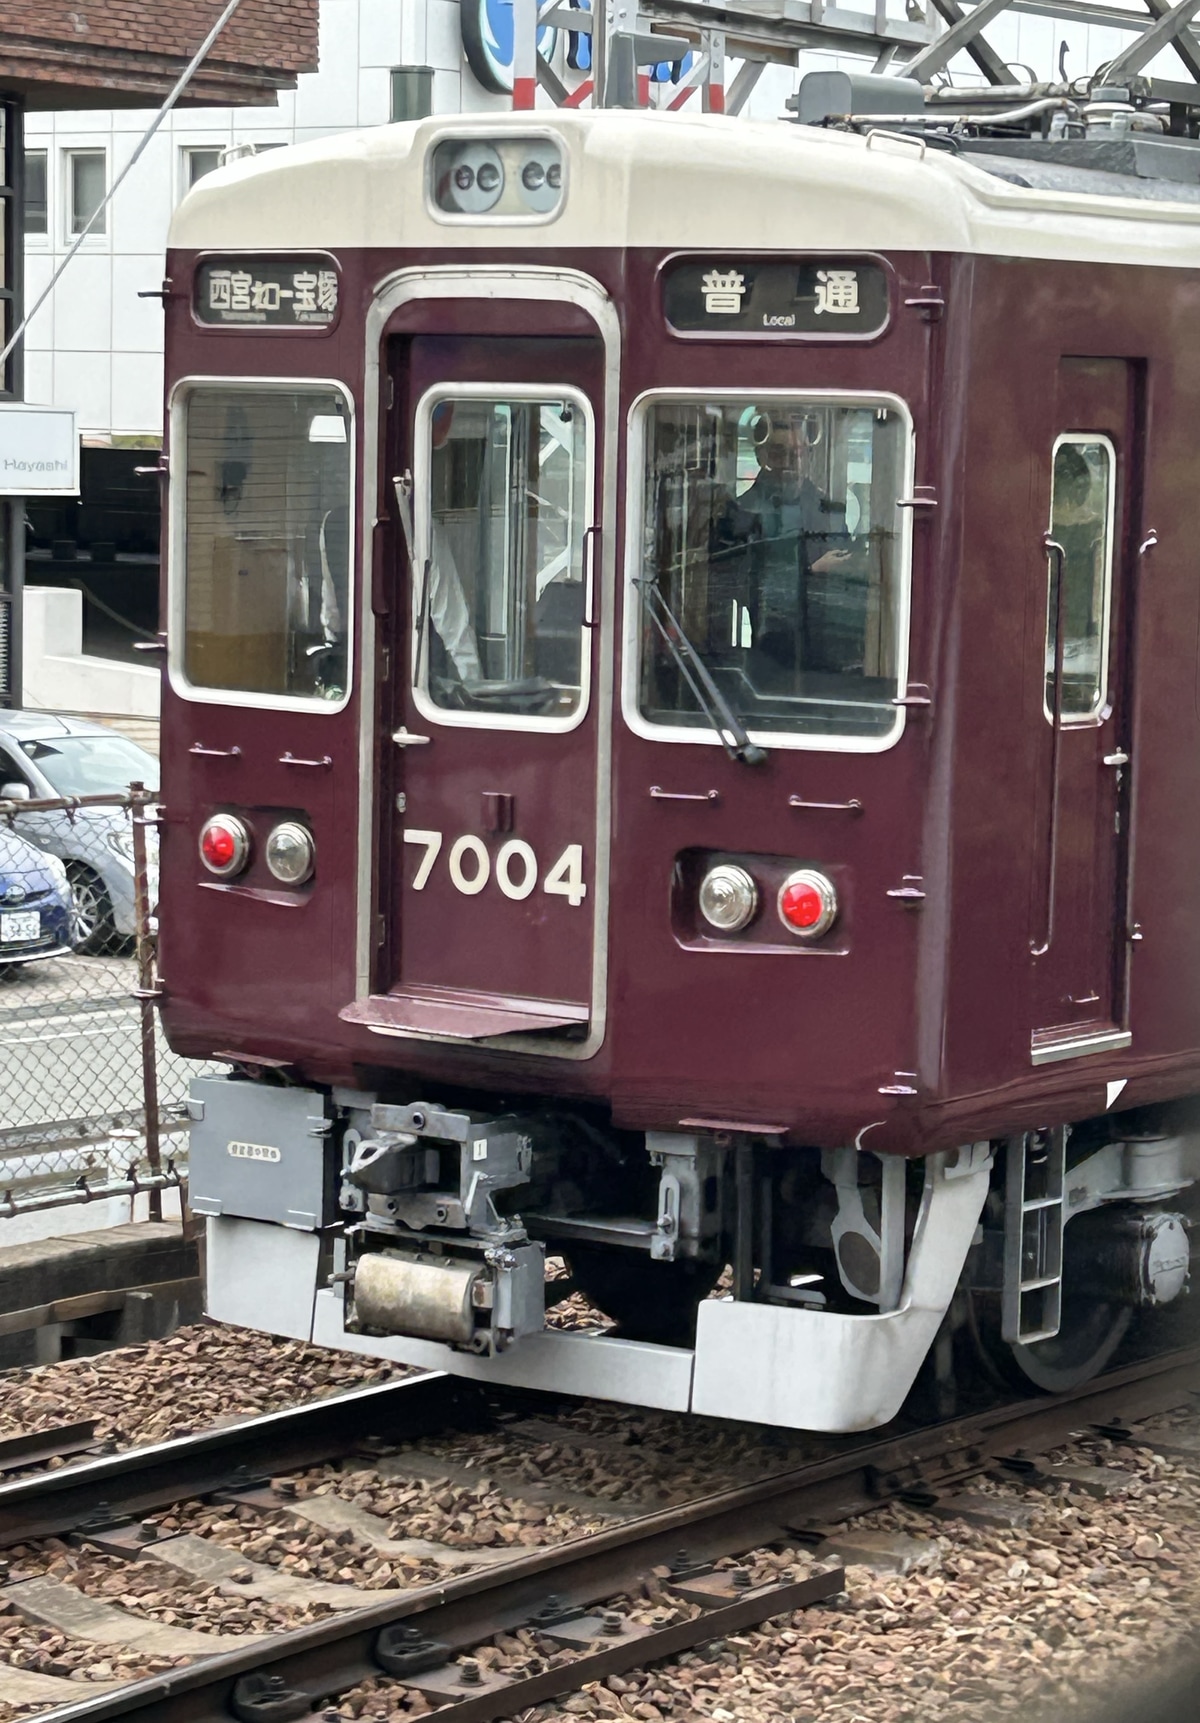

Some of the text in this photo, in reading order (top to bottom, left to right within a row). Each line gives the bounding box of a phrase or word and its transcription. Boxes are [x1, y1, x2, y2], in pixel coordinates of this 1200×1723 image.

[701, 269, 860, 315] 普通
[763, 313, 796, 327] Local
[403, 829, 587, 907] 7004
